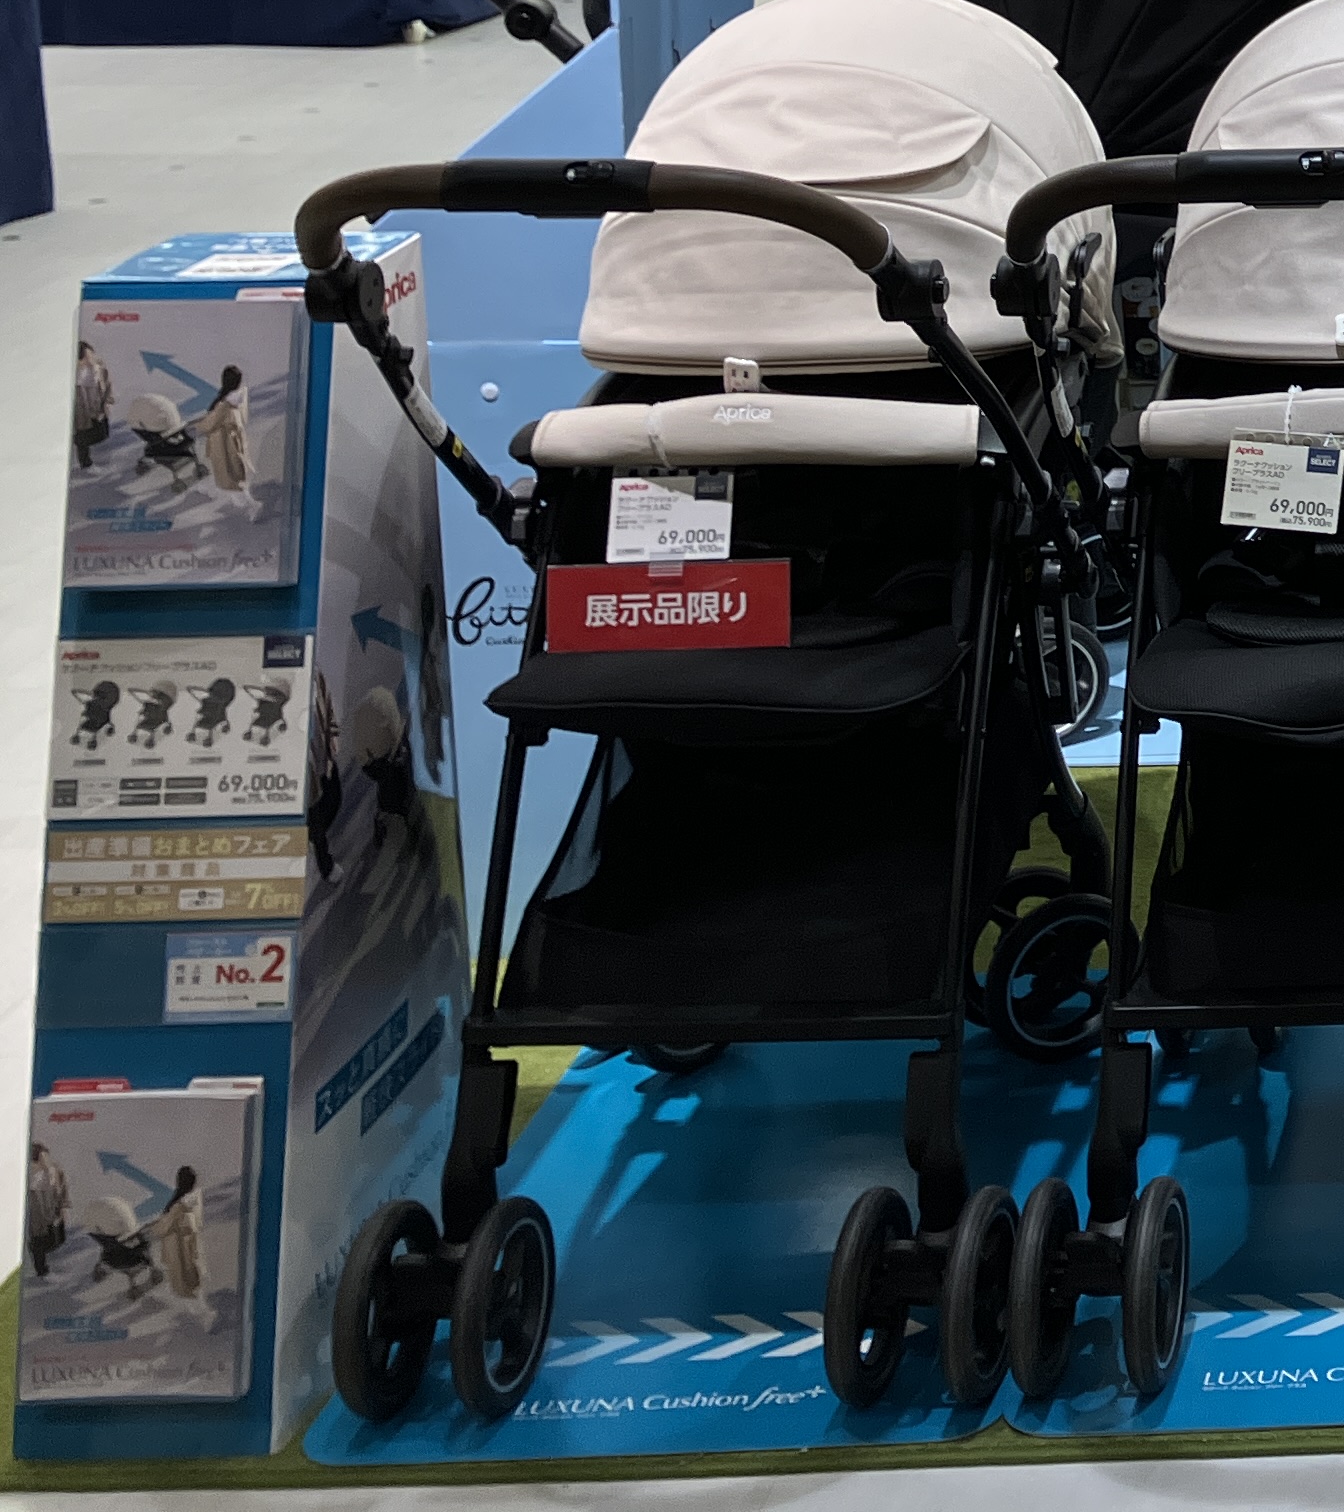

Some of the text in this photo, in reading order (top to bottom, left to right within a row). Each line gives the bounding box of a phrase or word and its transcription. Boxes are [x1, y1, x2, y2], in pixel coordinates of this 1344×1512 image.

[94, 311, 140, 325] Aprica
[714, 405, 772, 424] Aprica
[1235, 446, 1264, 456] Aprica
[1310, 458, 1337, 467] SELECT
[1270, 498, 1334, 517] 69,000円
[658, 530, 725, 545] 69,000円
[586, 592, 748, 627] 展示品限り
[1204, 1369, 1319, 1385] LUXUNA
[514, 1395, 634, 1417] LUXUNA
[643, 1391, 747, 1412] Cushion
